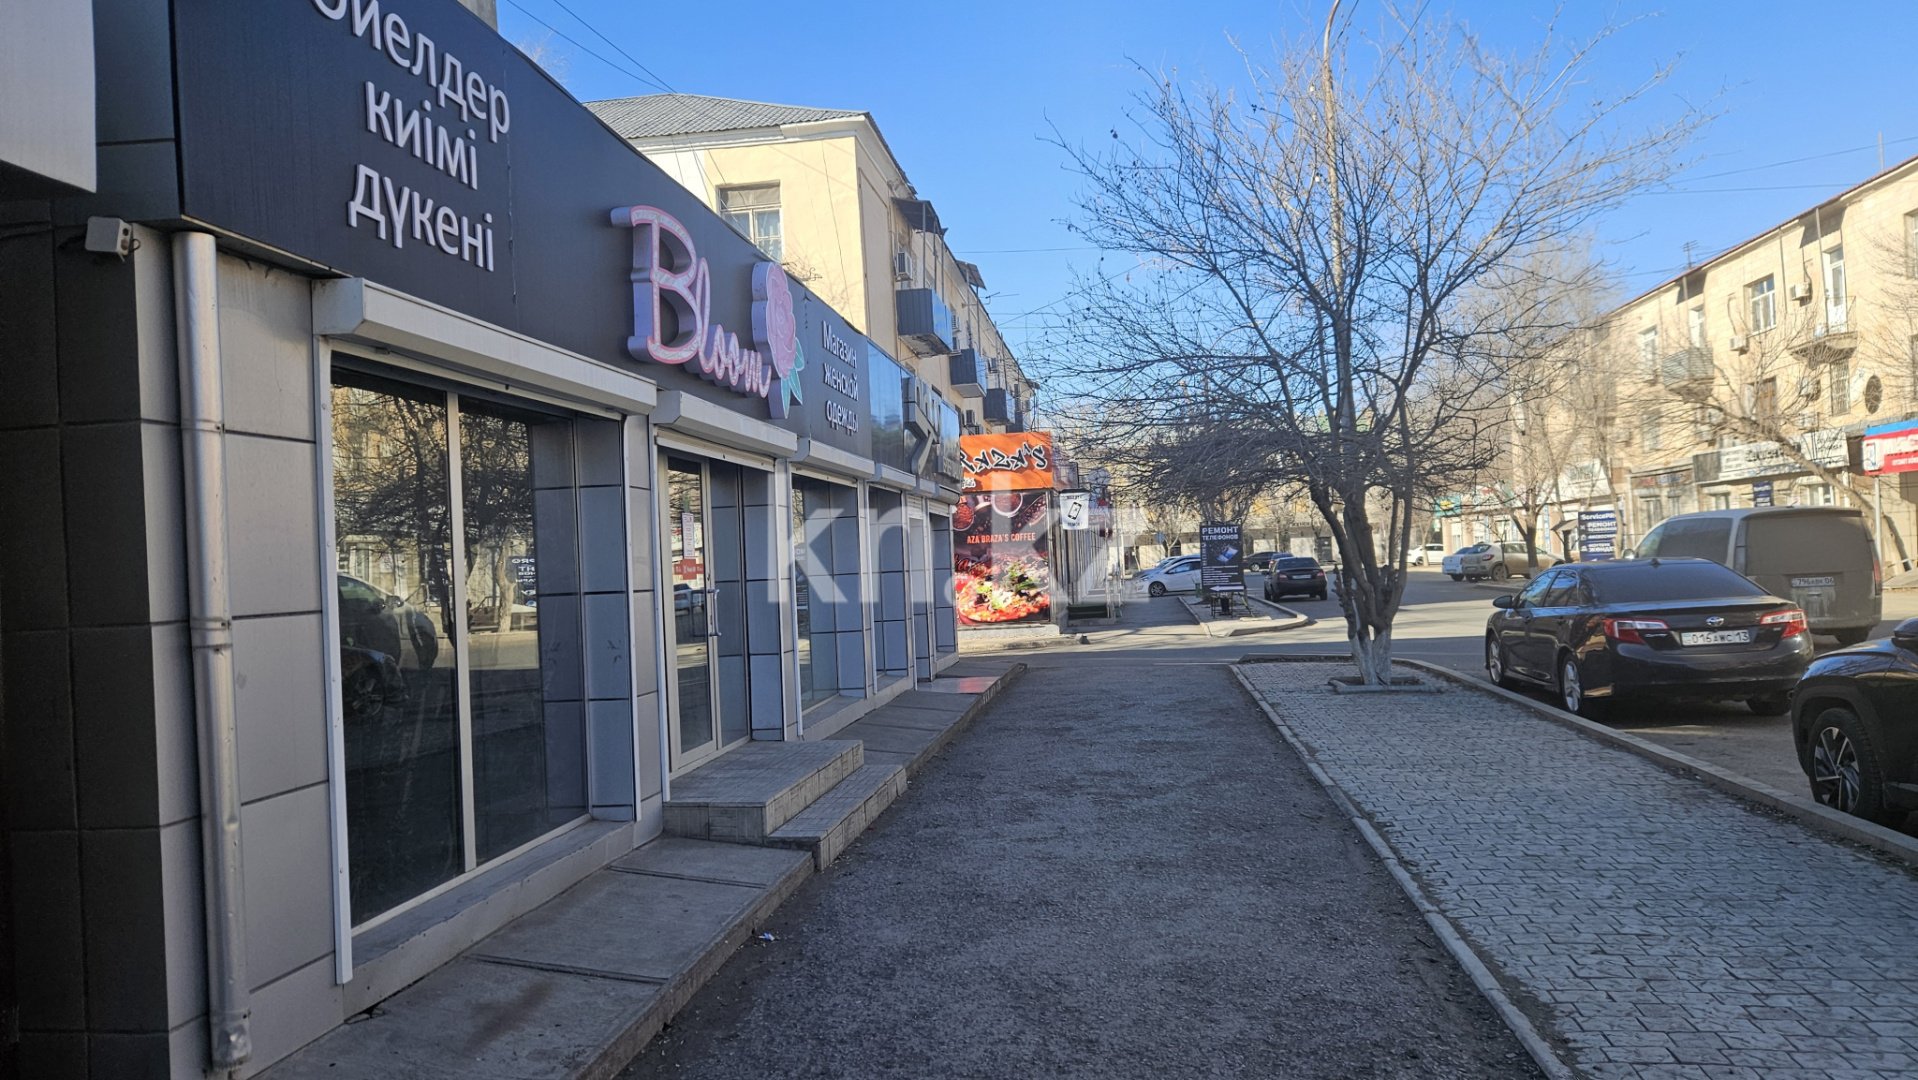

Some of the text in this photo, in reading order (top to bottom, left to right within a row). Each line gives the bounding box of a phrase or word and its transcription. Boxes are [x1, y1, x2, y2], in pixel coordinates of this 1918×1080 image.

[365, 81, 478, 190] киімі
[348, 164, 494, 272] дүкені
[822, 320, 858, 369] Магазин
[823, 362, 859, 401] женской
[826, 400, 859, 436] одежды
[967, 532, 1035, 544] AZA BRAZA'S COFFEE
[1202, 526, 1239, 535] РЕМОНТ
[1735, 631, 1749, 642] 13
